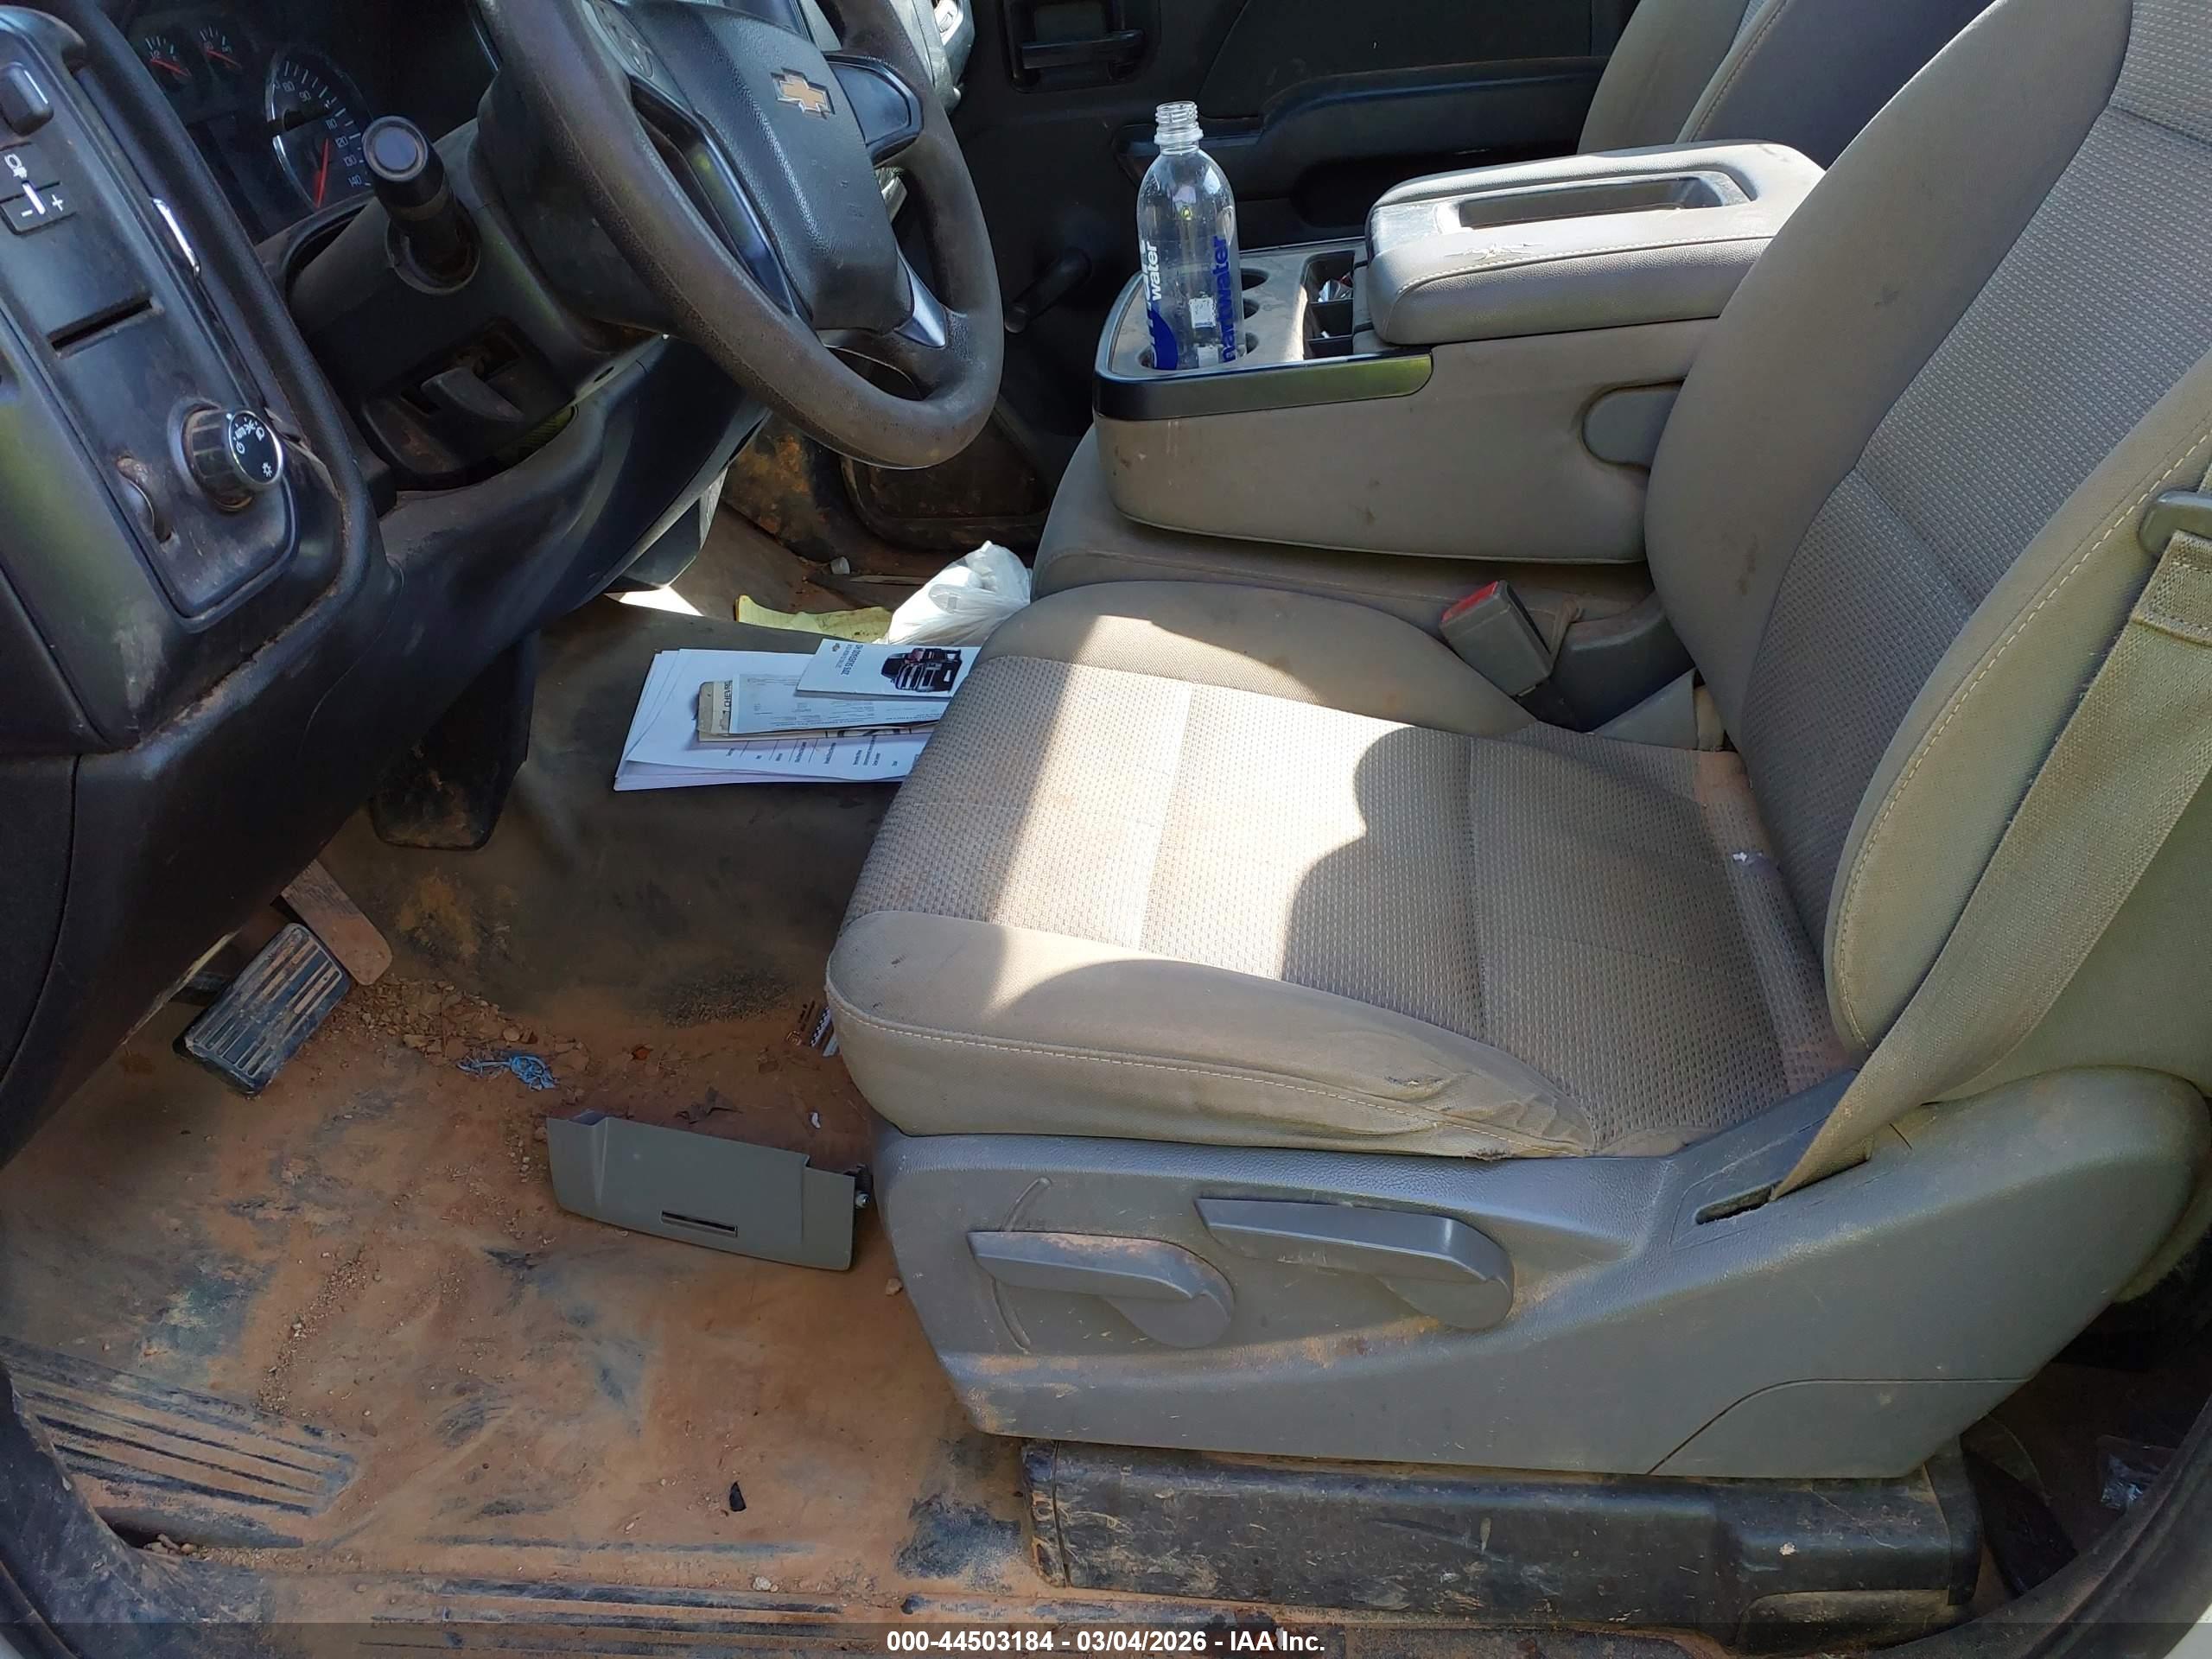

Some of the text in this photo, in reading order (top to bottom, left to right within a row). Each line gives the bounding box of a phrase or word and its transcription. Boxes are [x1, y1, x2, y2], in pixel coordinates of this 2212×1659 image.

[334, 136, 348, 148] 120
[348, 175, 362, 187] 140
[1147, 240, 1162, 302] water
[1212, 235, 1236, 363] martwater
